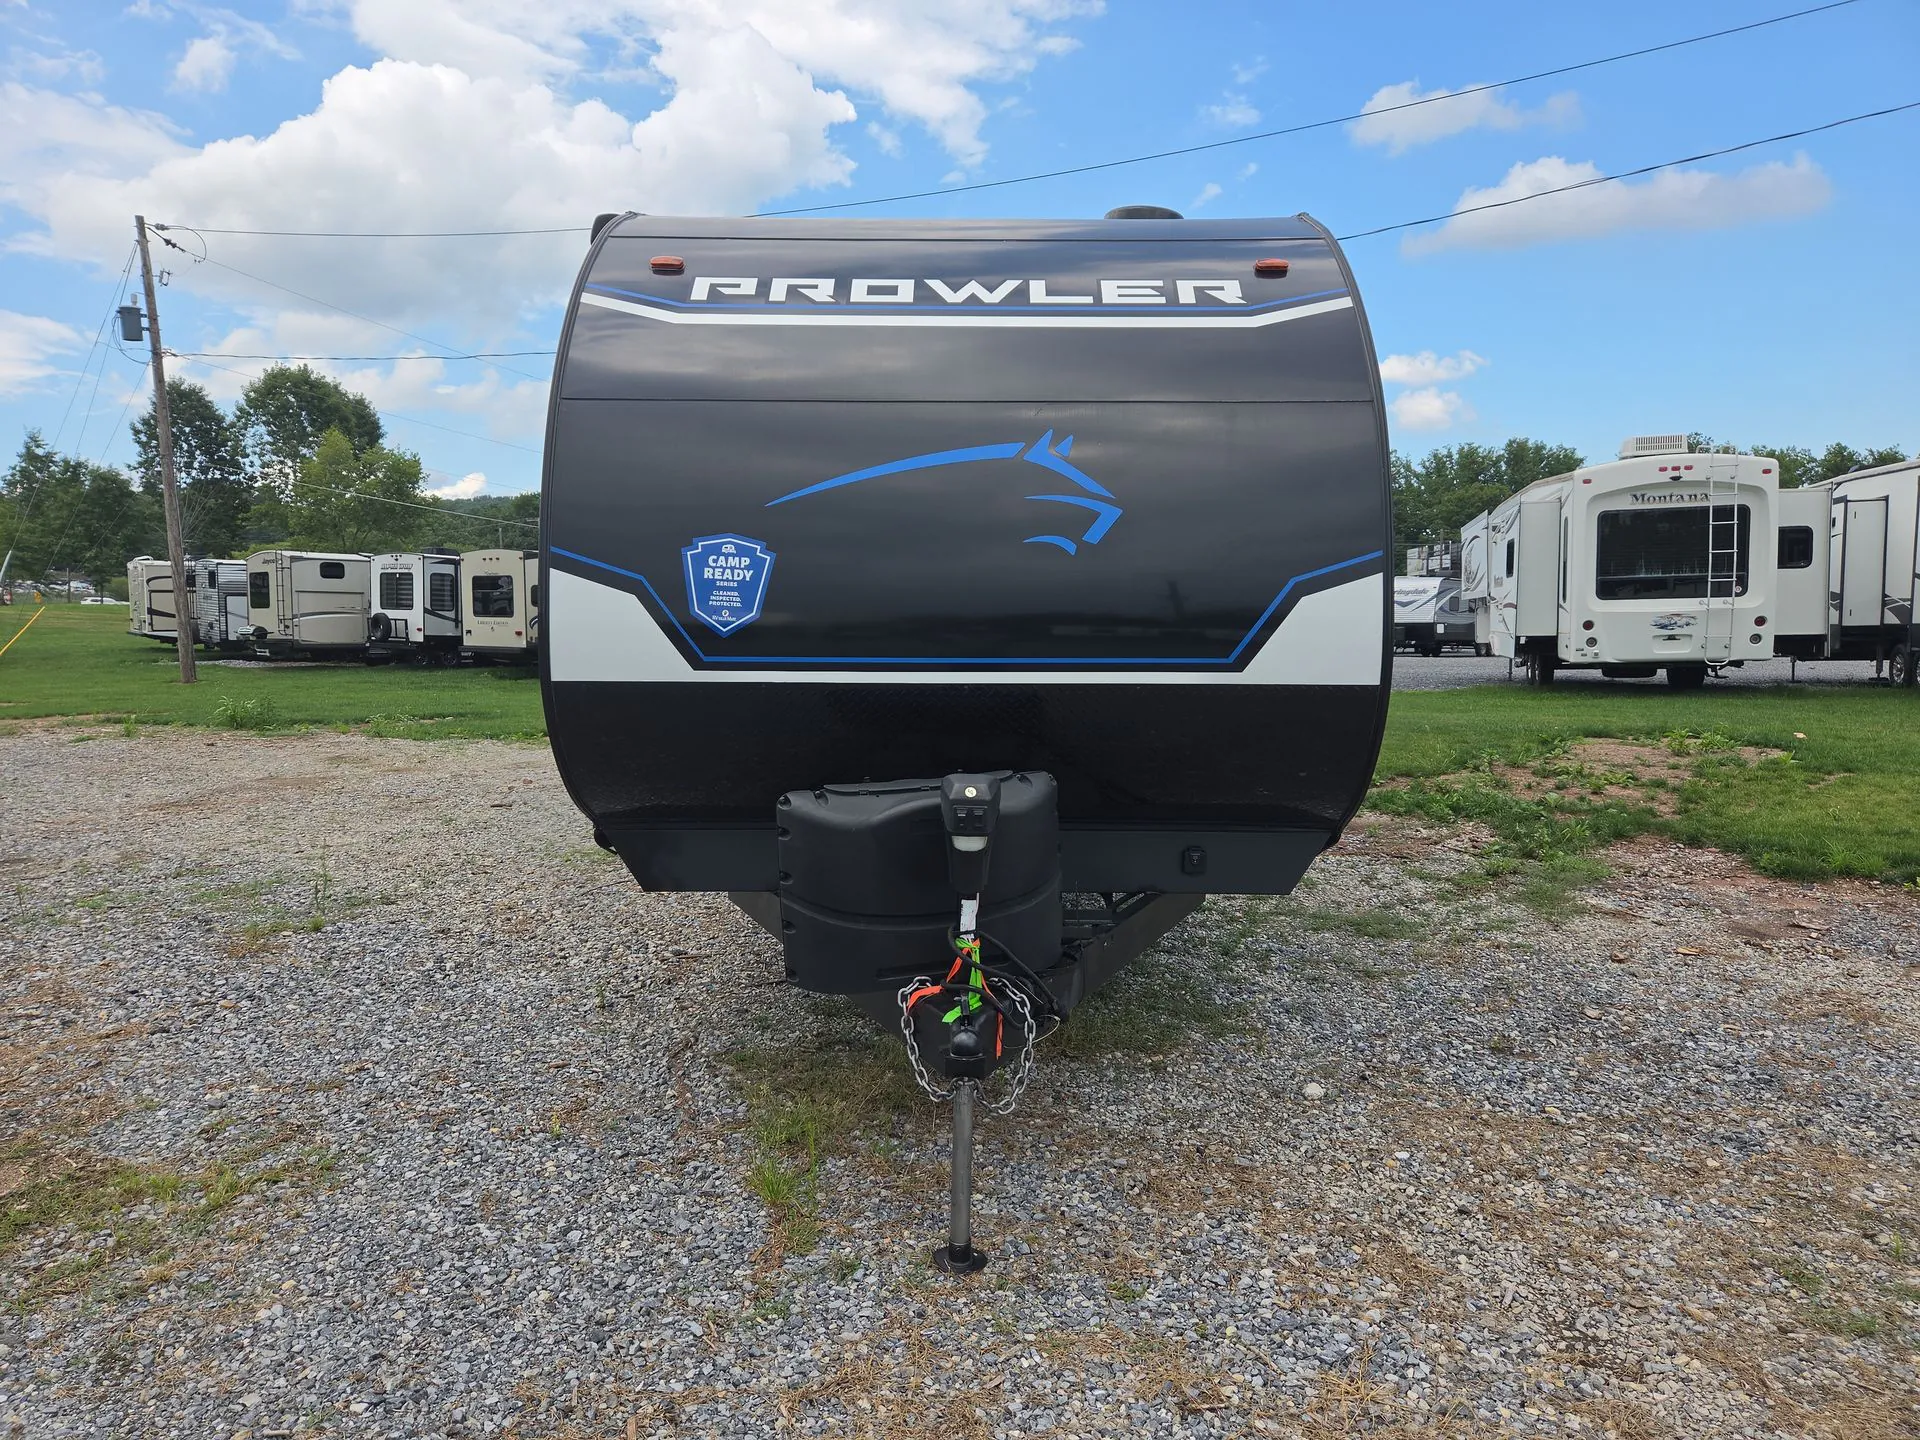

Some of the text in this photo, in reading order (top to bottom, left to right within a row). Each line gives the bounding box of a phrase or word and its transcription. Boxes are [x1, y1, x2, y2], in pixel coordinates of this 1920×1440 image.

[690, 276, 1247, 304] PROWLER
[1629, 492, 1710, 505] Montana
[708, 555, 751, 568] CAMP
[703, 567, 754, 581] READY
